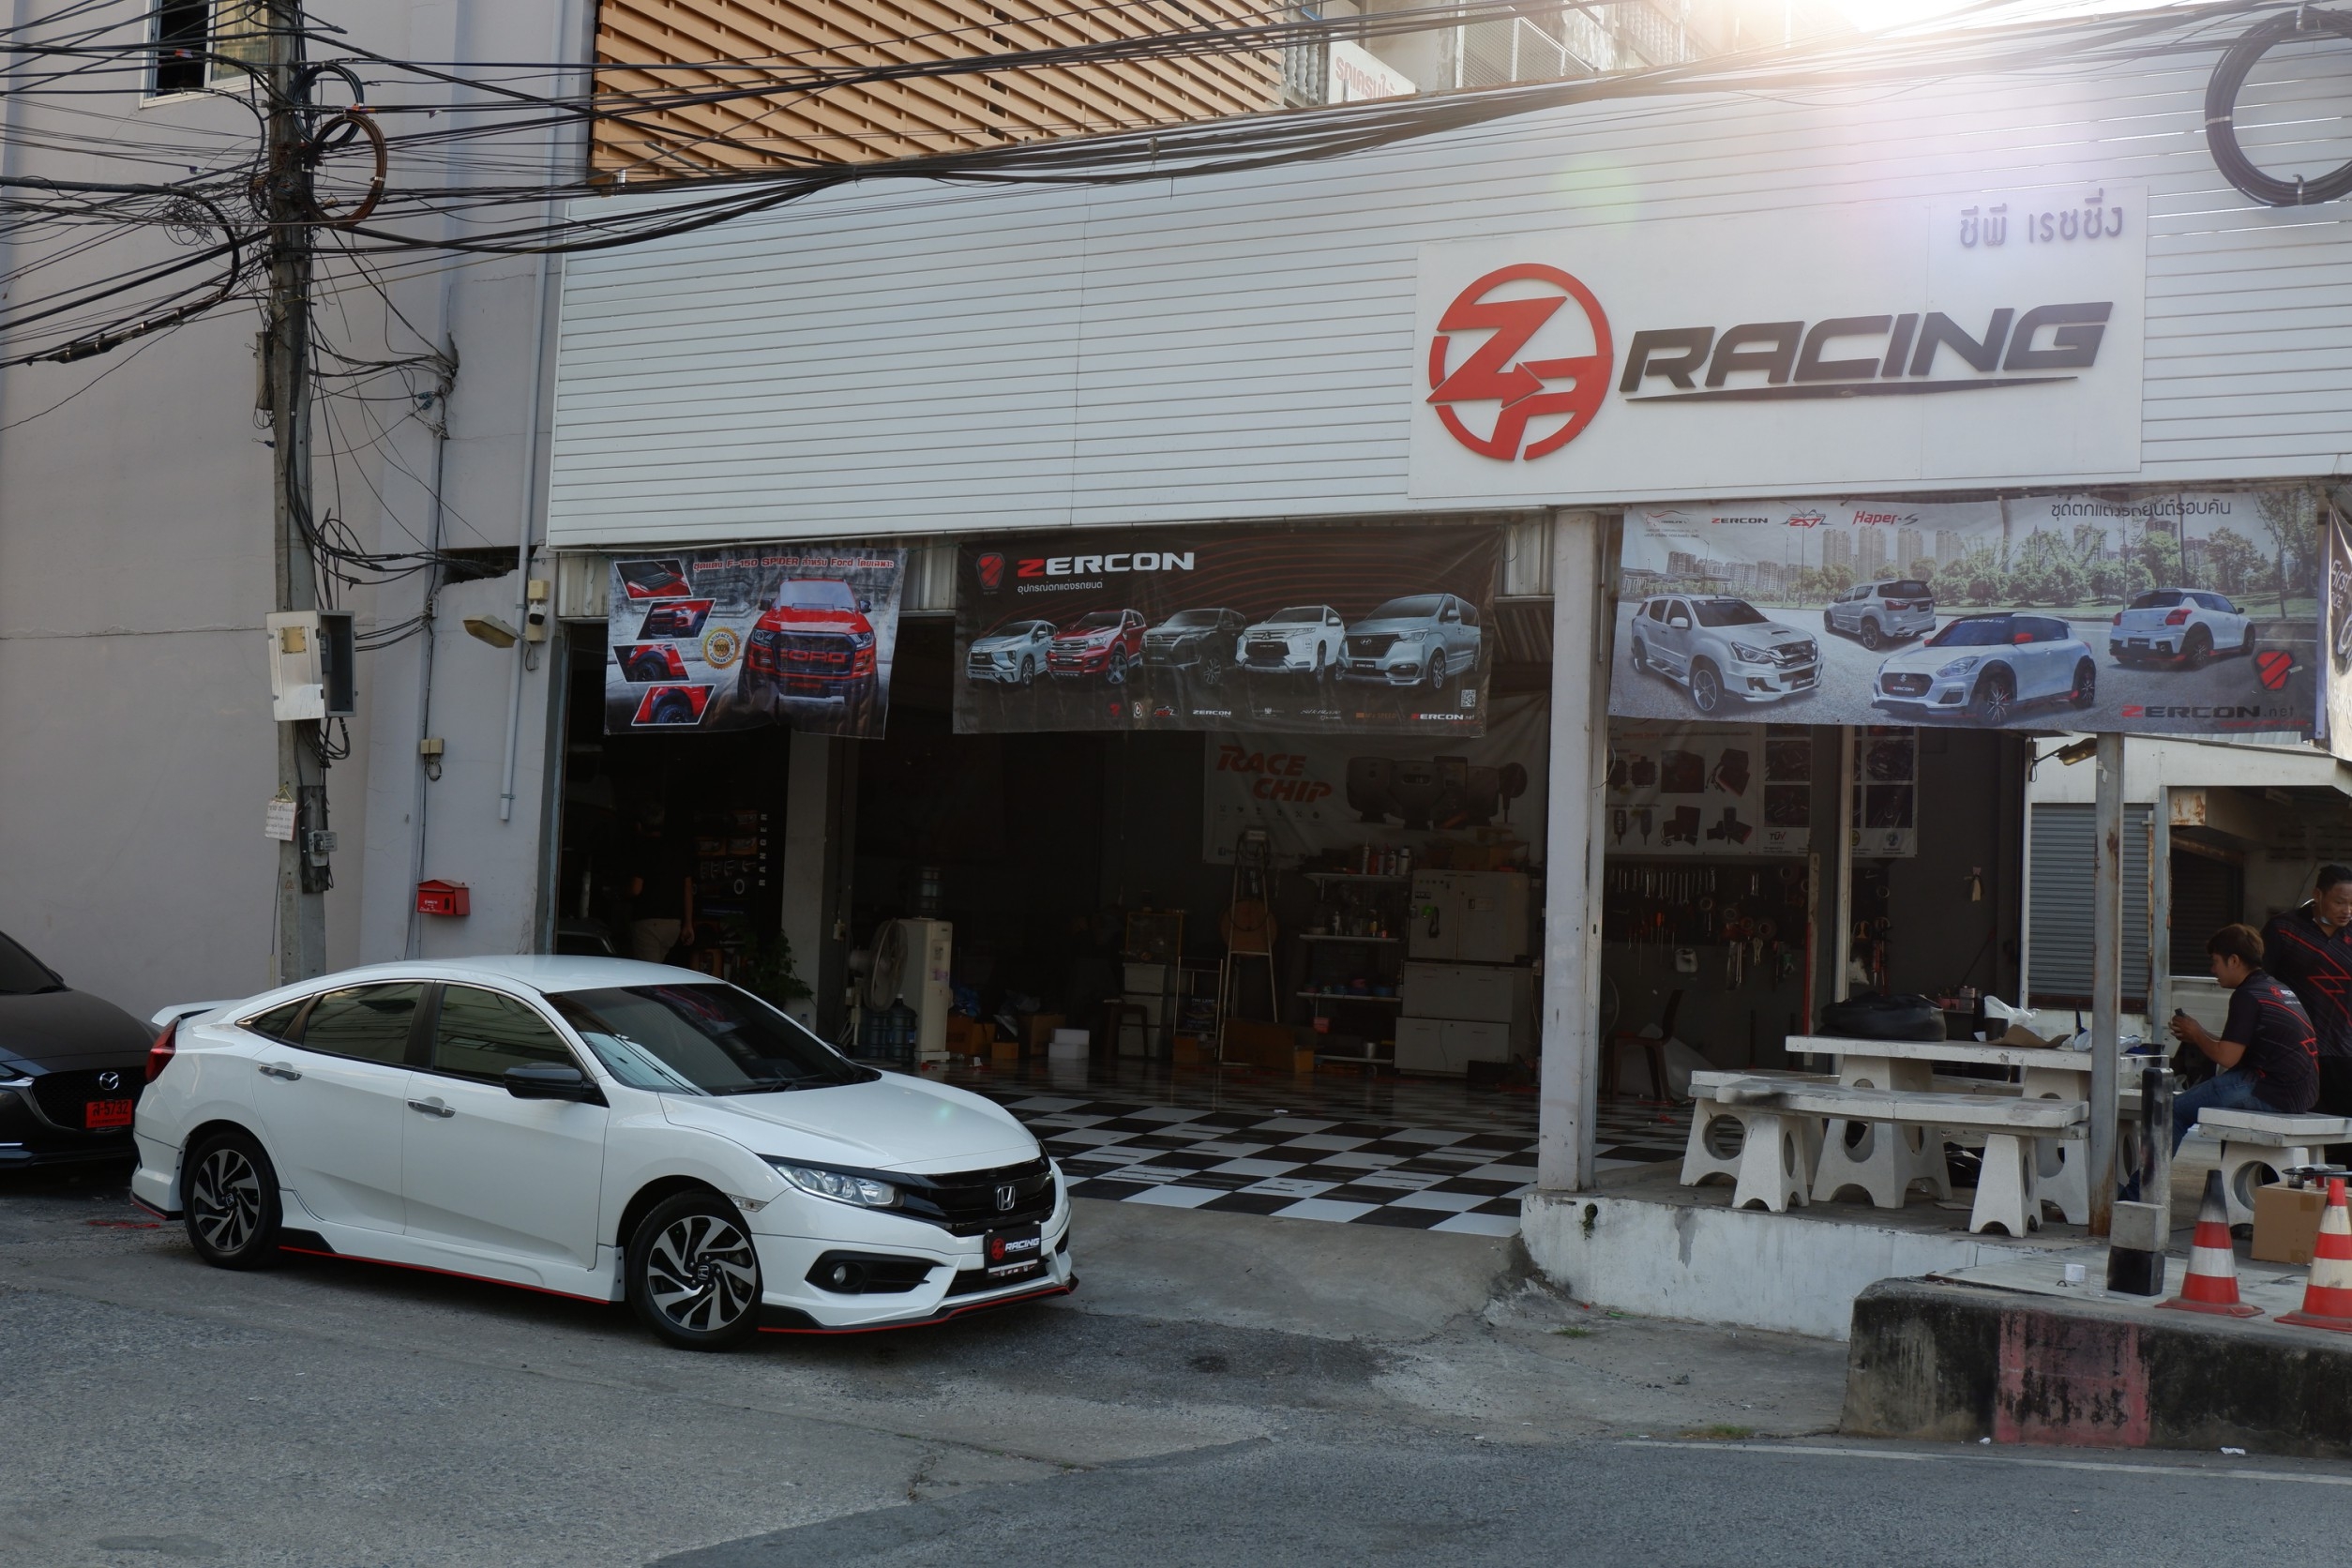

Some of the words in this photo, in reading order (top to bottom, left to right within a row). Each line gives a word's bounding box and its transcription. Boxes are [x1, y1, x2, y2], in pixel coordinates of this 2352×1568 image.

[1619, 301, 2114, 392] RACING
[727, 559, 758, 568] F-150
[761, 557, 799, 566] SPIDER
[831, 558, 853, 567] Ford
[1017, 551, 1195, 578] ZERCON
[1216, 745, 1307, 776] RACE
[1253, 778, 1333, 803] CHIP
[1005, 1238, 1040, 1252] RACING
